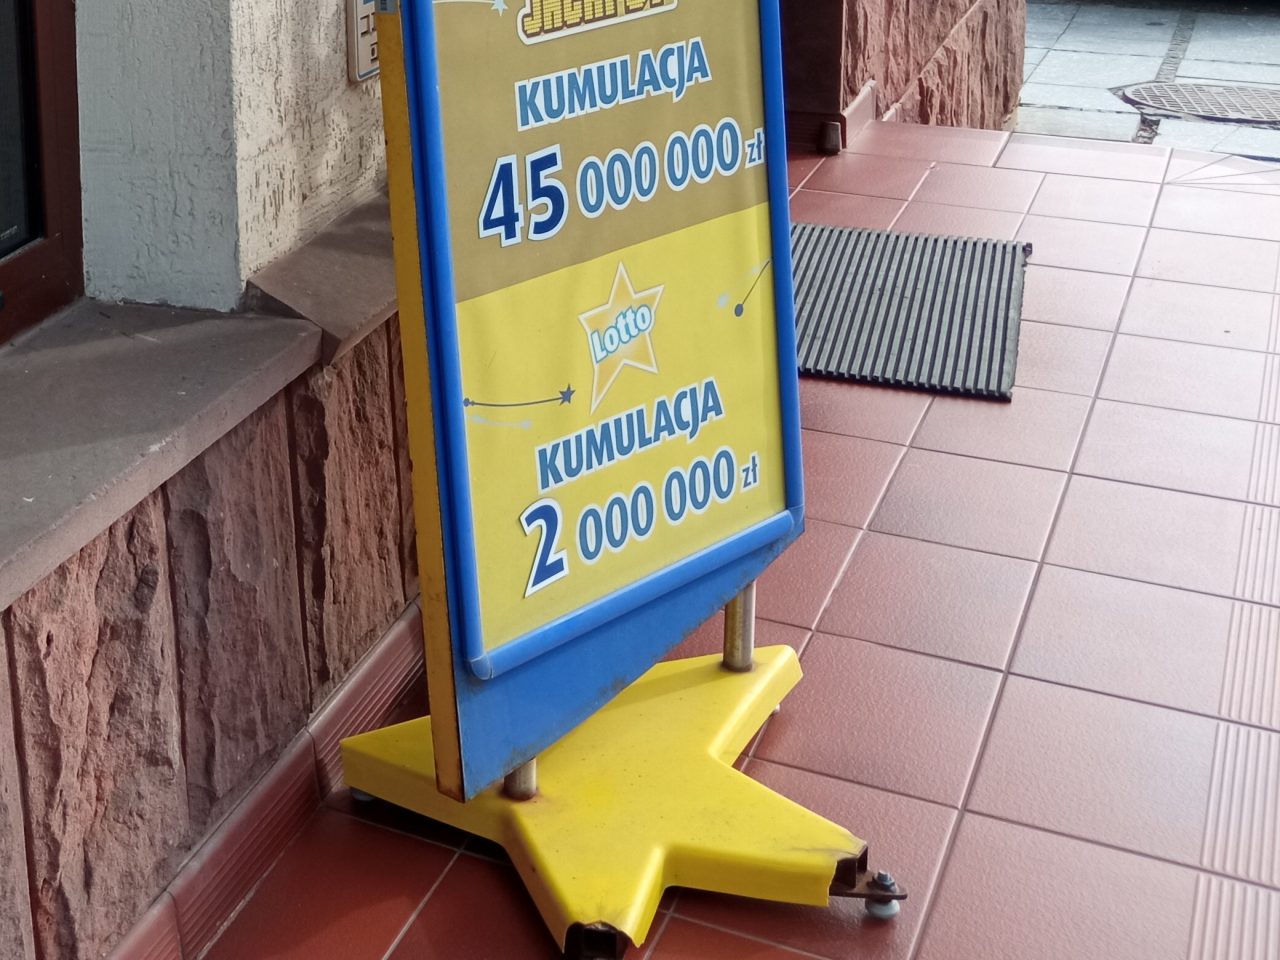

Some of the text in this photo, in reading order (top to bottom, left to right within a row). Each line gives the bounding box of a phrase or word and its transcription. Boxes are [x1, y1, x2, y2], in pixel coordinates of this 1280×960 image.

[518, 39, 710, 128] KUMULACJA
[480, 120, 765, 245] 45 000 000 zł
[590, 304, 652, 363] Lotto
[537, 380, 723, 490] KUMULACJA
[523, 449, 758, 593] 2 000 000 zł
